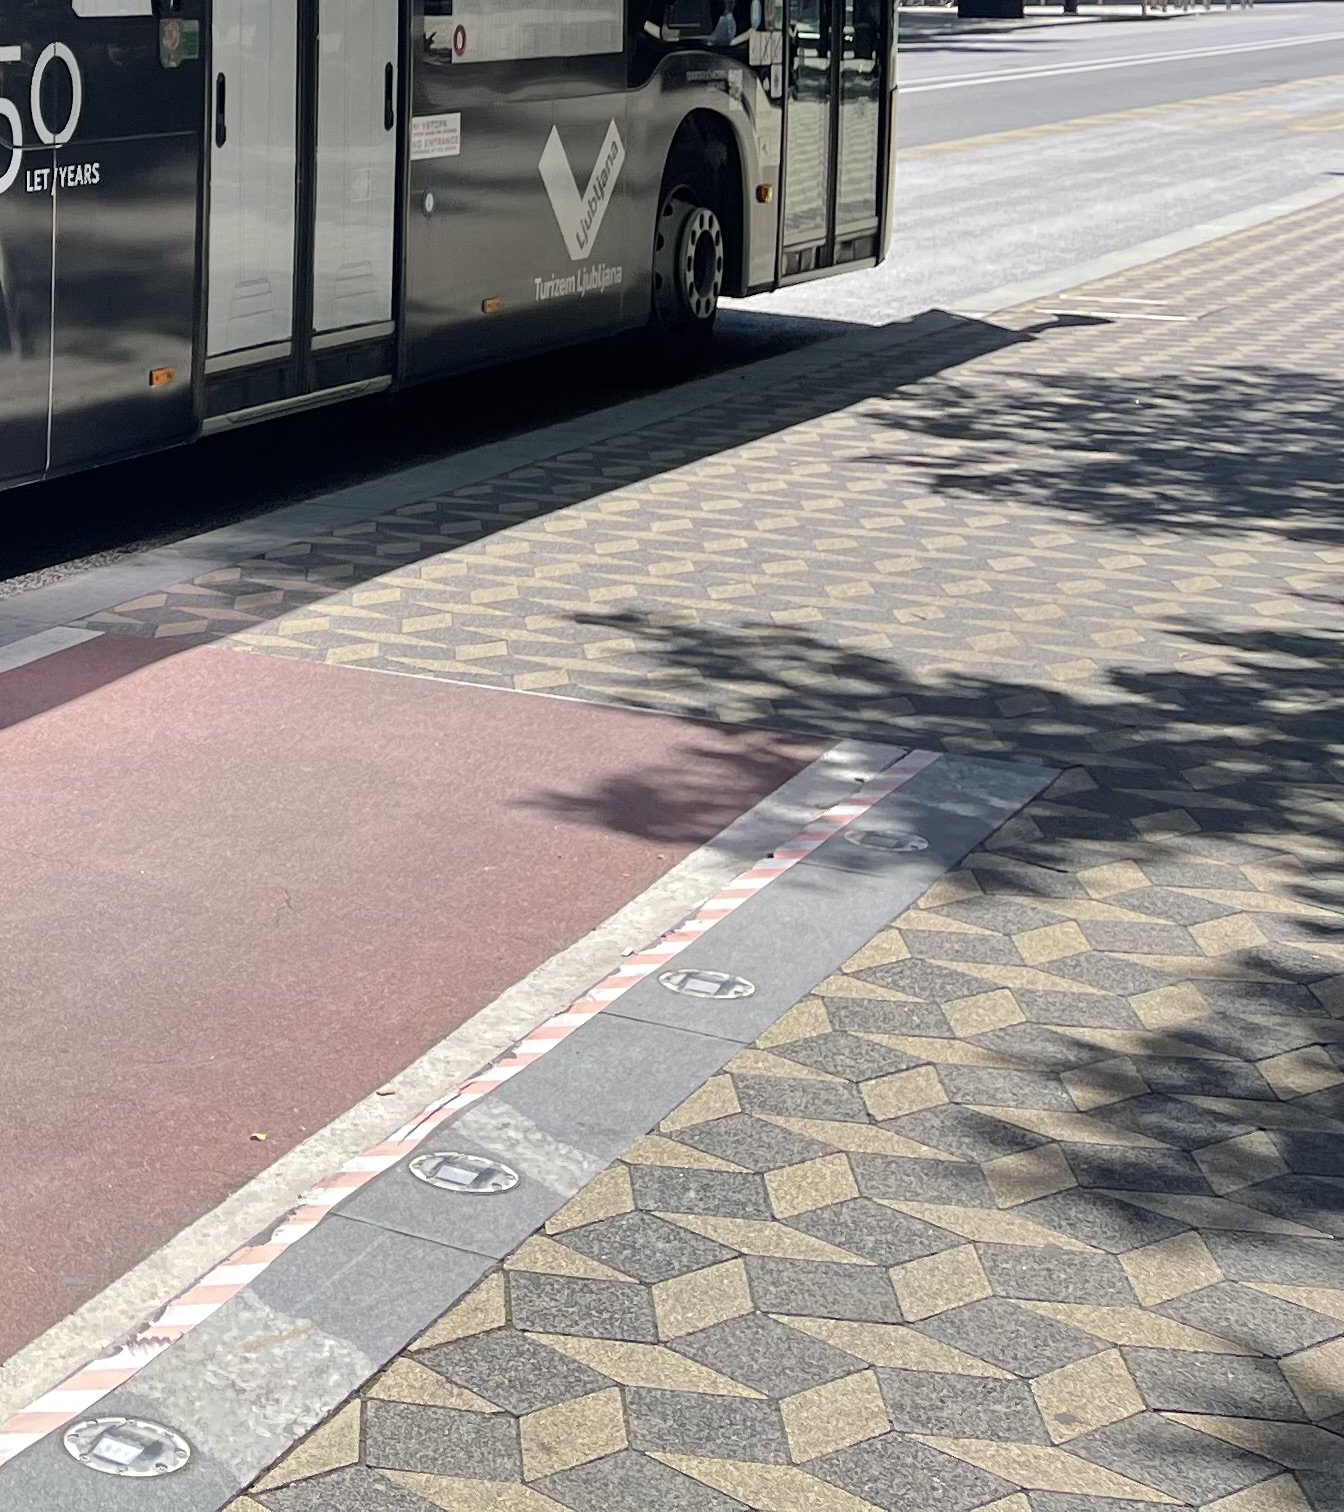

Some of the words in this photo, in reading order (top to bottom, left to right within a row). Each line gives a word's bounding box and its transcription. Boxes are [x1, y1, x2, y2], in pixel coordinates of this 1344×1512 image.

[575, 141, 619, 251] Ljubljana
[534, 274, 575, 301] Turizem
[577, 264, 622, 298] Ljubljana
